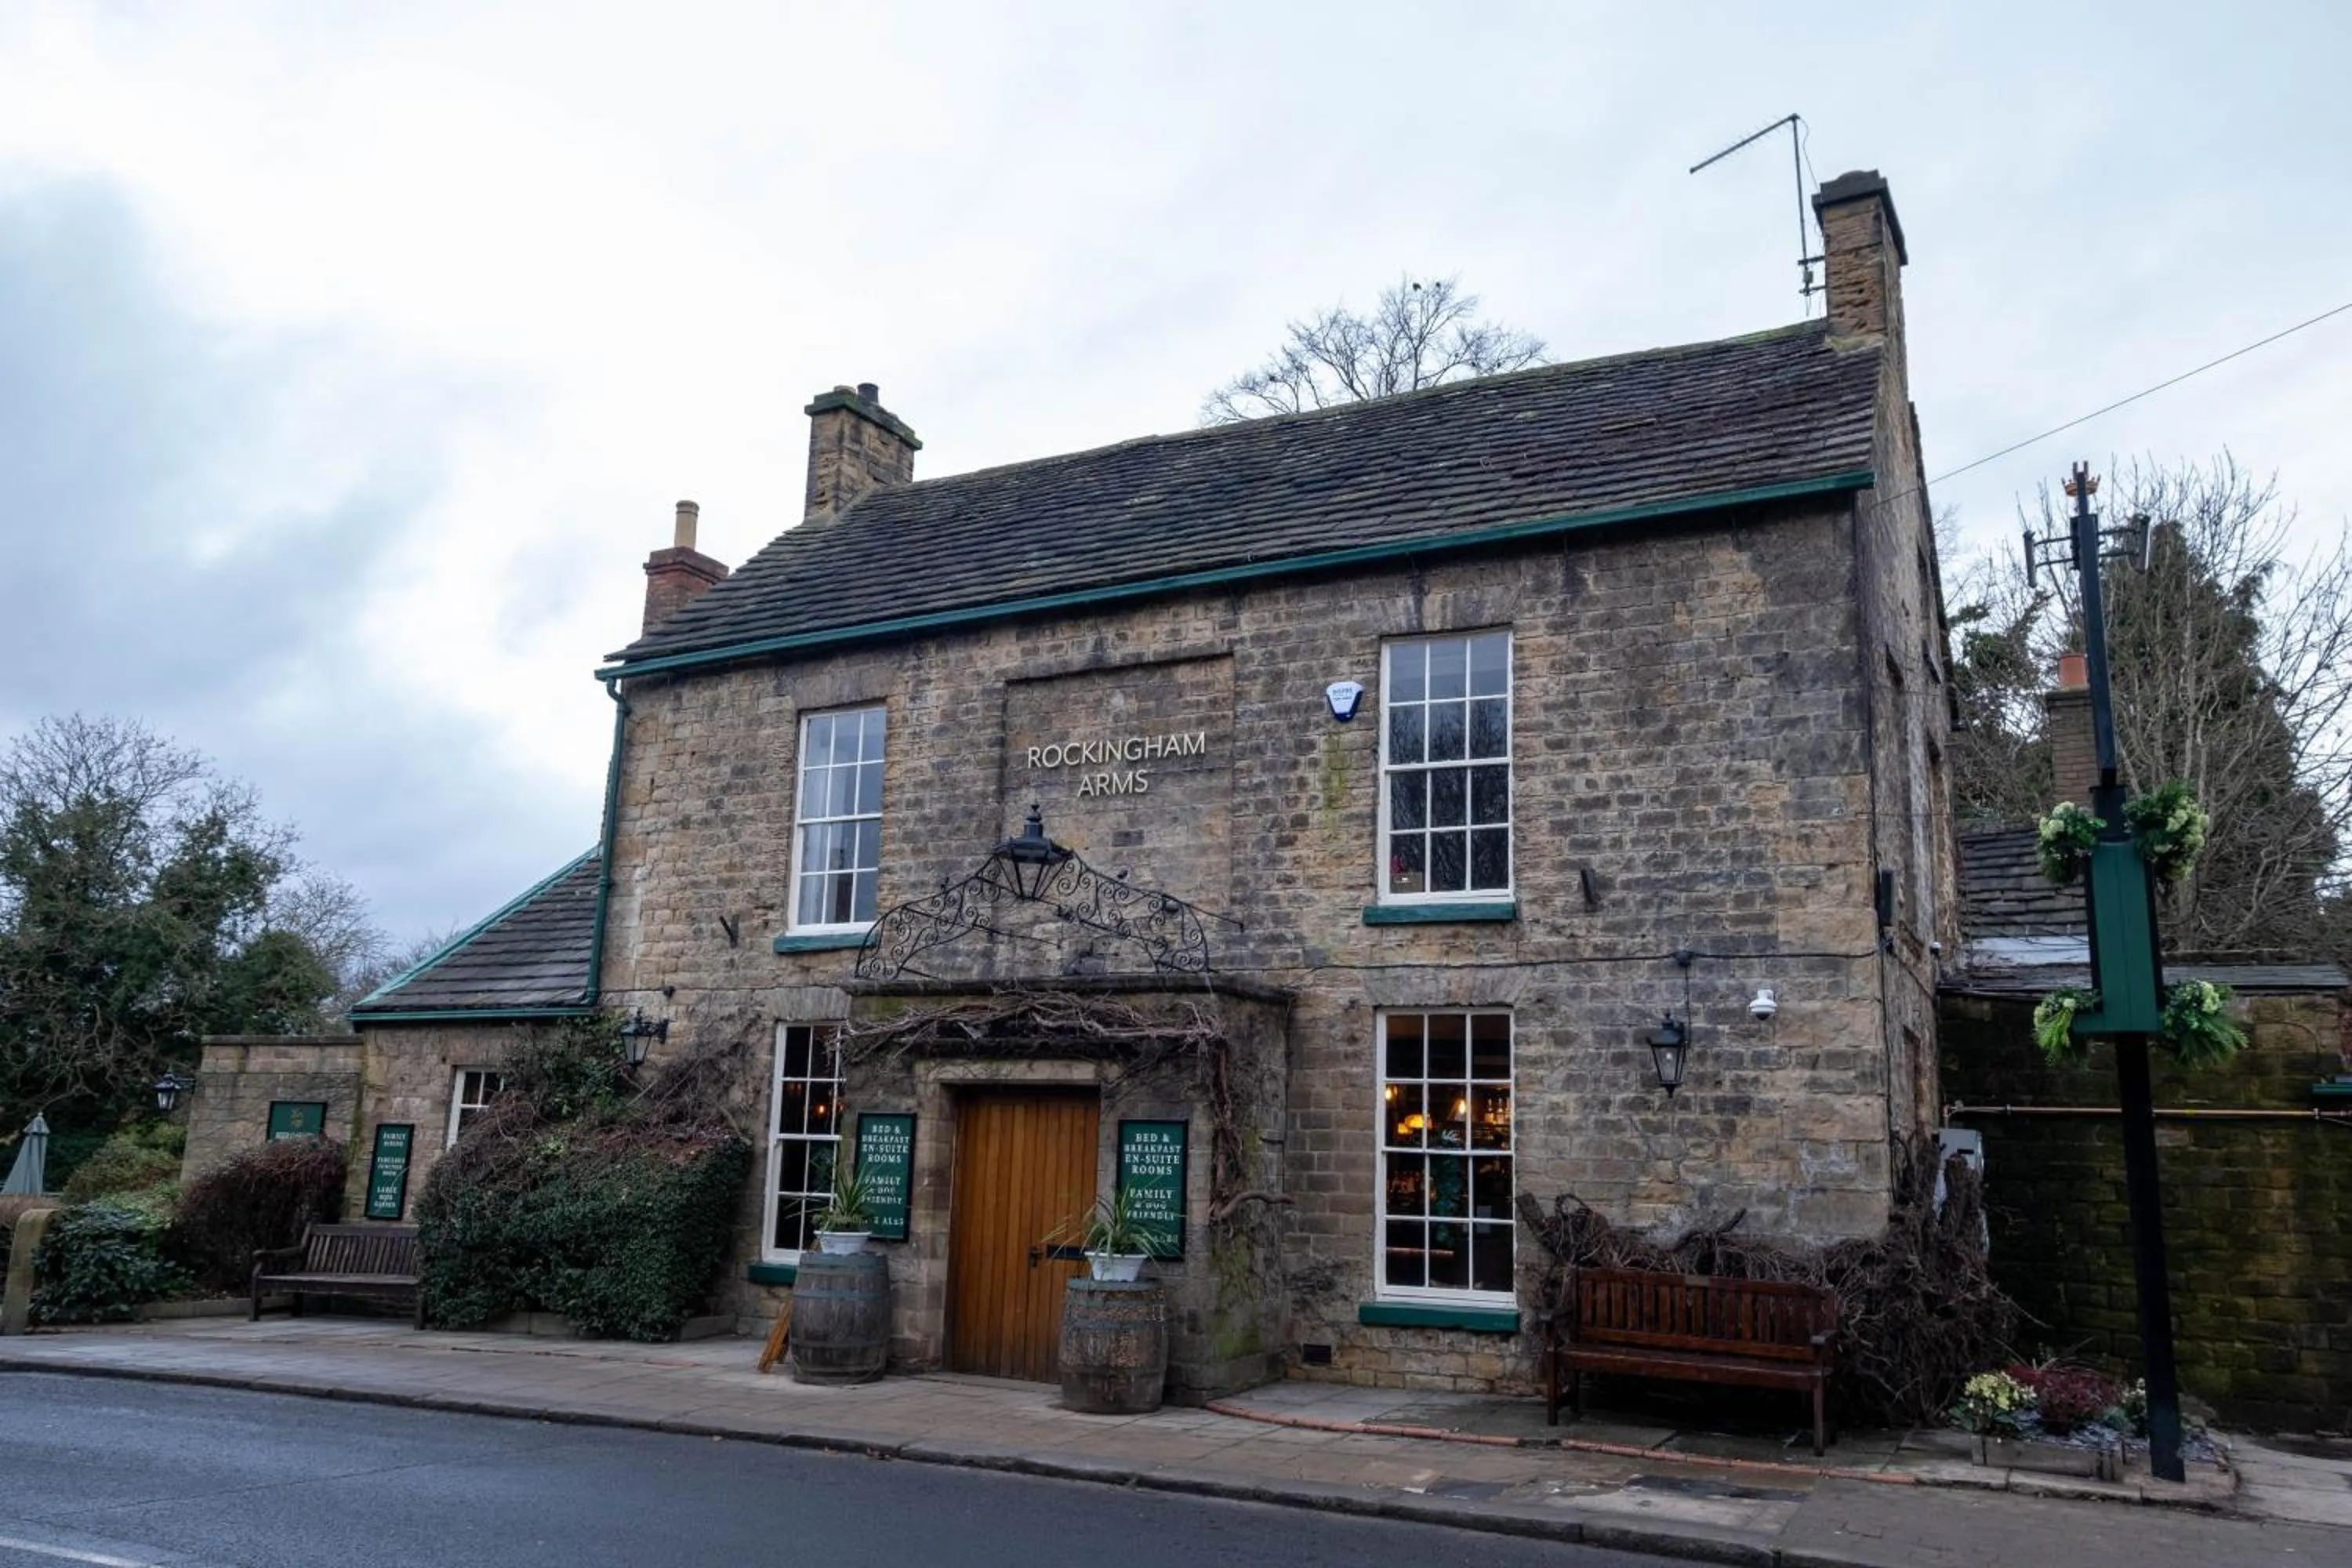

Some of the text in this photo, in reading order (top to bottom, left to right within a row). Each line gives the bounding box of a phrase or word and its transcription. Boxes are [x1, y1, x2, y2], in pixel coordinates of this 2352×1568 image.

[1027, 731, 1205, 769] ROCKINGHAM
[1077, 769, 1149, 797] ARMS
[872, 1124, 901, 1134] BED &
[862, 1134, 909, 1143] BREAKFAST
[1135, 1133, 1170, 1142] BED &
[862, 1145, 909, 1153] EN-SUITE
[1123, 1144, 1181, 1153] BREAKFAST
[868, 1154, 902, 1163] ROOMS
[1124, 1154, 1180, 1164] EN-SUITE
[1131, 1165, 1172, 1175] ROOMS
[865, 1175, 901, 1185] FAMILY
[1130, 1188, 1172, 1199] FAMILY
[1127, 1210, 1174, 1221] FRIENDLY
